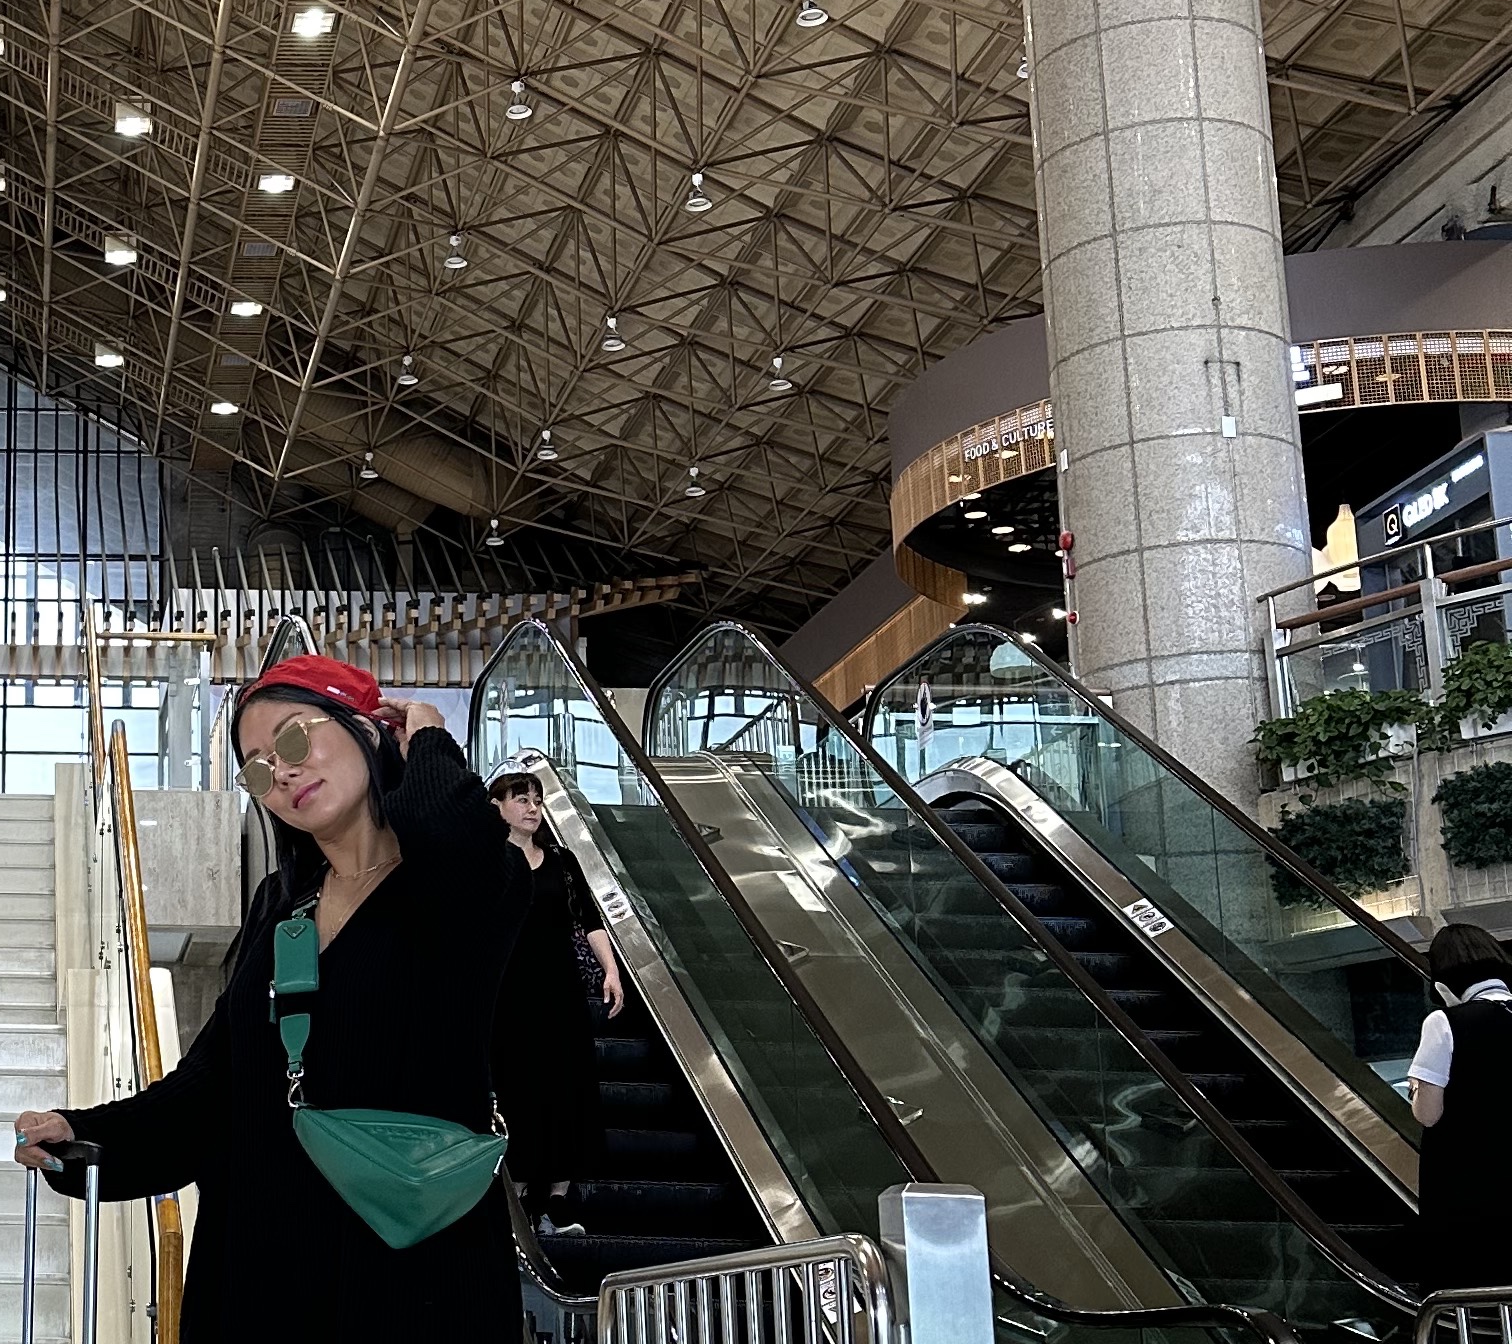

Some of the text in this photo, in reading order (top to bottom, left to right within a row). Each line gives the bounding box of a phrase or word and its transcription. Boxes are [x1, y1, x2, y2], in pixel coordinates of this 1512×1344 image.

[964, 418, 1055, 463] FOOD & CULTURE
